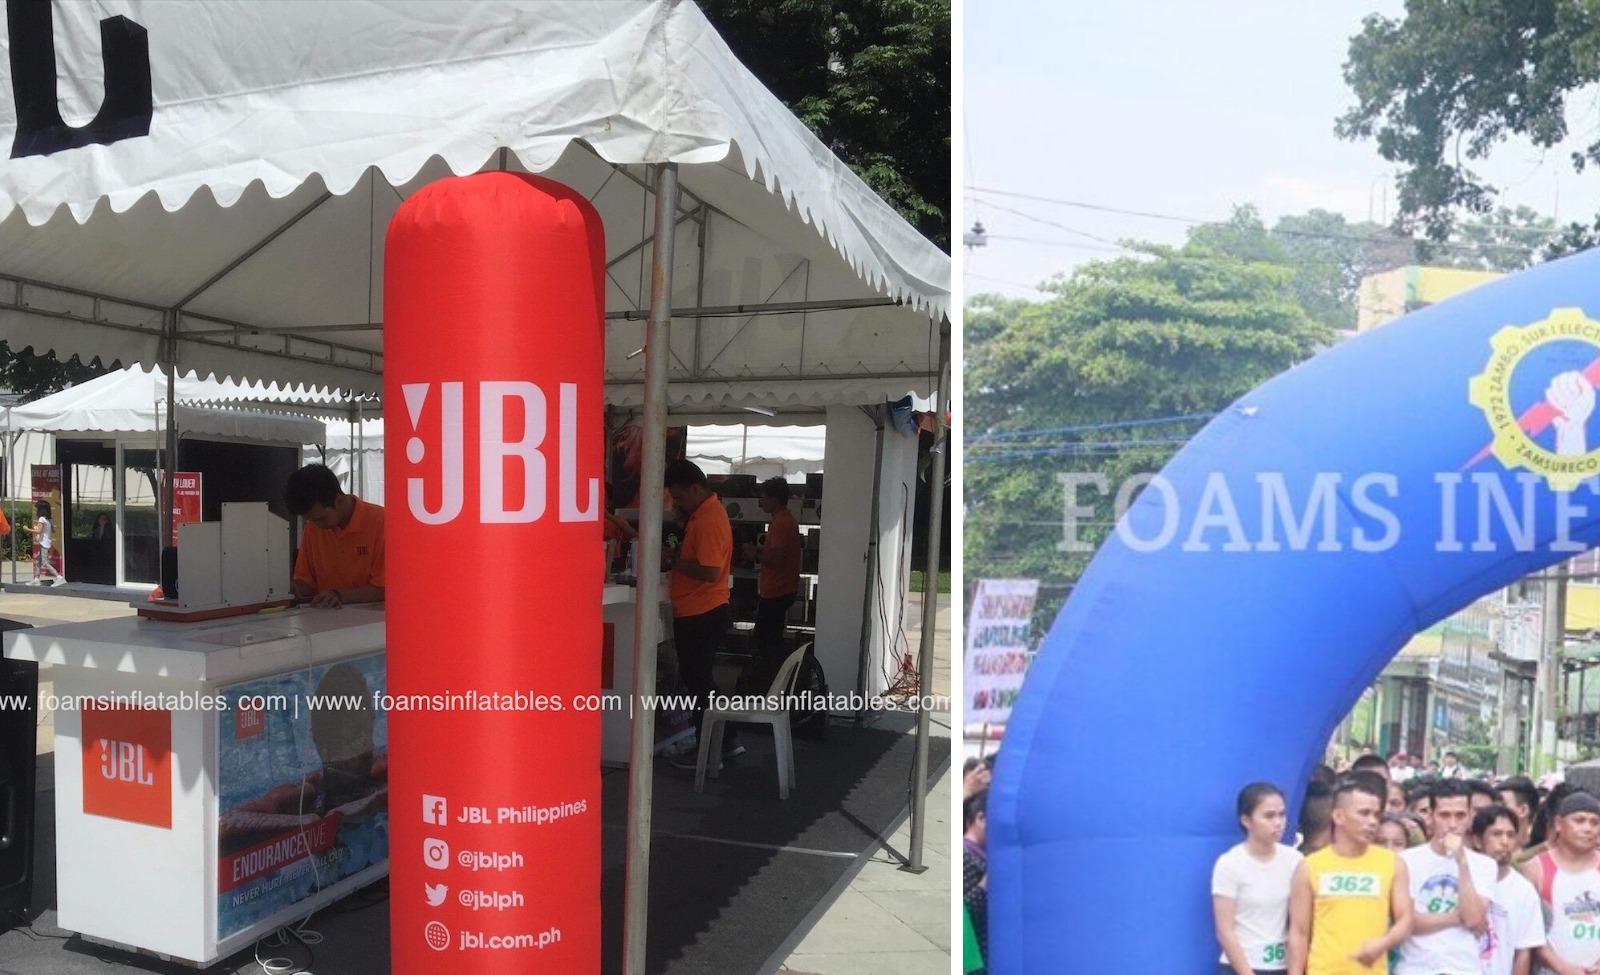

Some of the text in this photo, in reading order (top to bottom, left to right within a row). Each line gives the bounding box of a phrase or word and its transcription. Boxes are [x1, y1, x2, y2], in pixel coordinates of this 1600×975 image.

[402, 380, 600, 526] JBL
[100, 738, 154, 786] JBL
[457, 799, 588, 826] JBL Philippines
[457, 850, 525, 872] @jblph
[1329, 875, 1374, 893] 362
[458, 889, 525, 911] @jblph
[459, 926, 562, 951] jbl.com.ph
